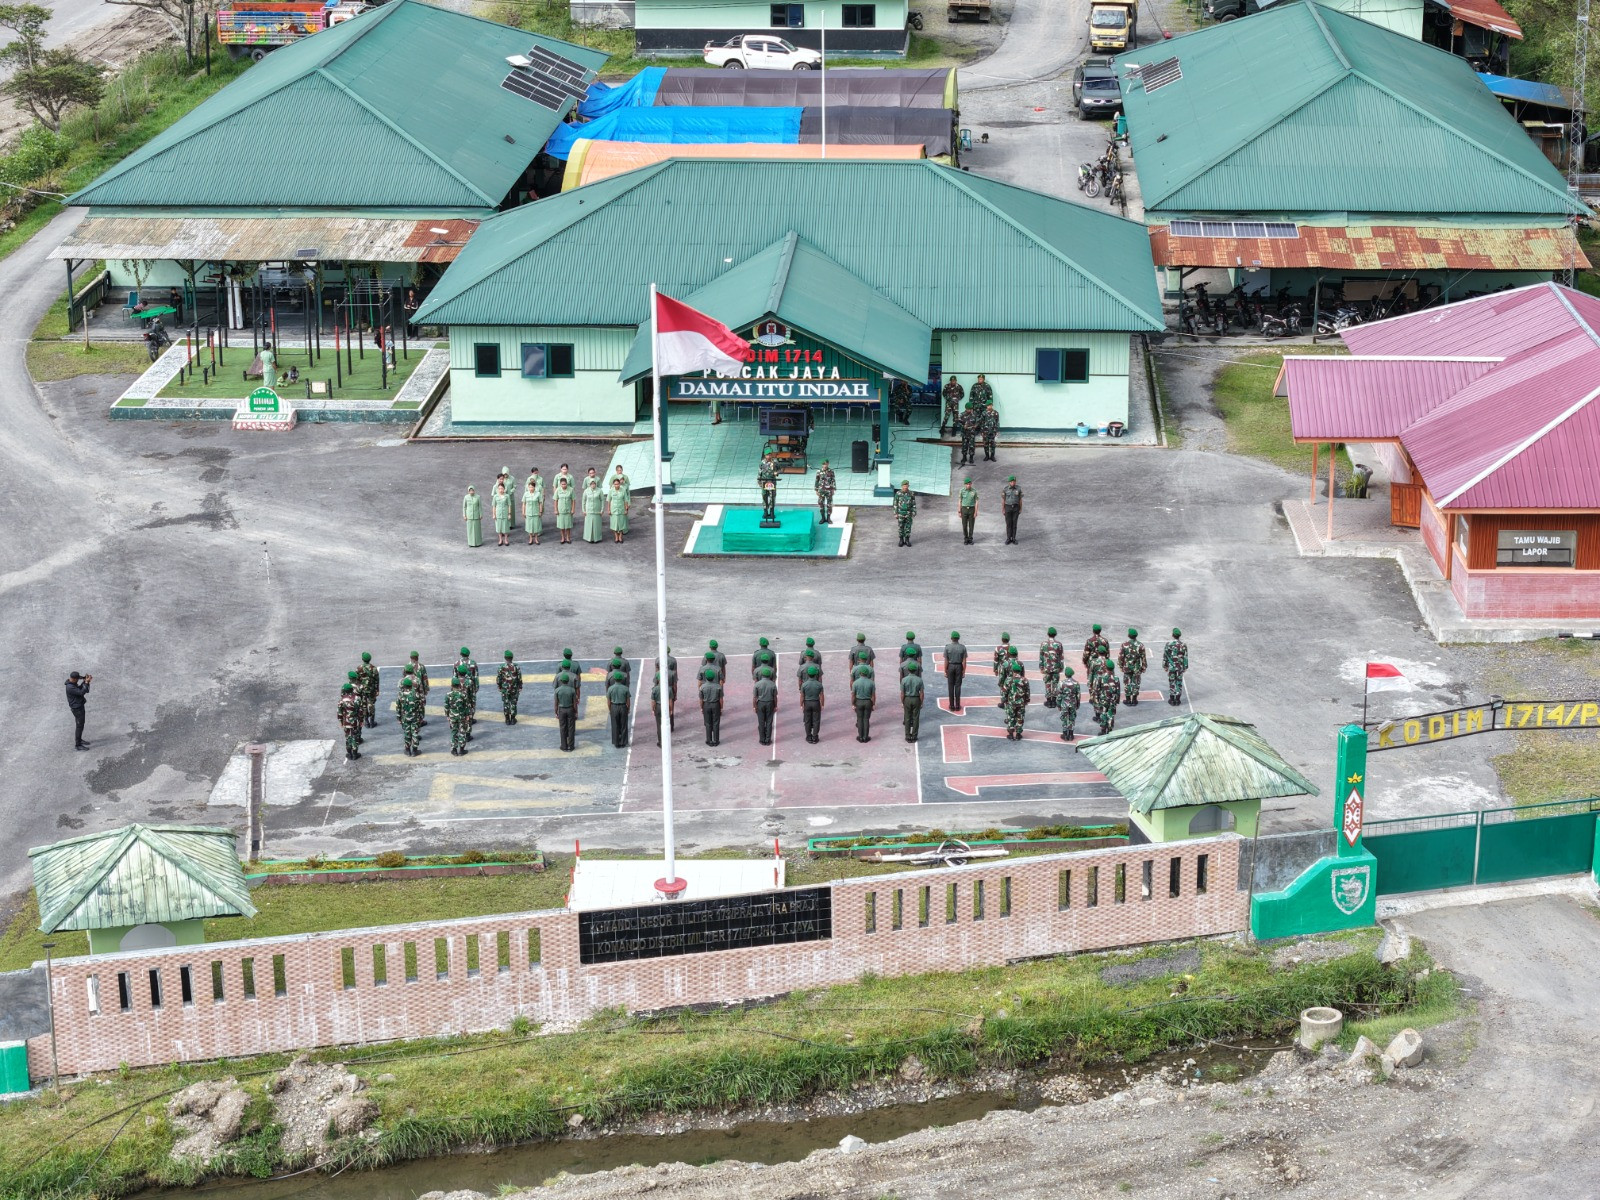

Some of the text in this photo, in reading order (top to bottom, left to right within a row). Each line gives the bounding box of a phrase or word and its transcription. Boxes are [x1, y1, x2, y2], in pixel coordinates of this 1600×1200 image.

[745, 349, 823, 363] DIM 1714
[703, 366, 841, 379] PUCAK JAYA
[678, 381, 870, 397] DAMAI ITU INDAH
[1514, 536, 1561, 544] TAMU WAJIB
[1522, 548, 1548, 556] LAPOR
[1379, 703, 1600, 748] KODIM 1714/P
[640, 915, 673, 928] RESOR
[597, 938, 647, 954] KOMANDO
[649, 934, 684, 948] DISTRIK
